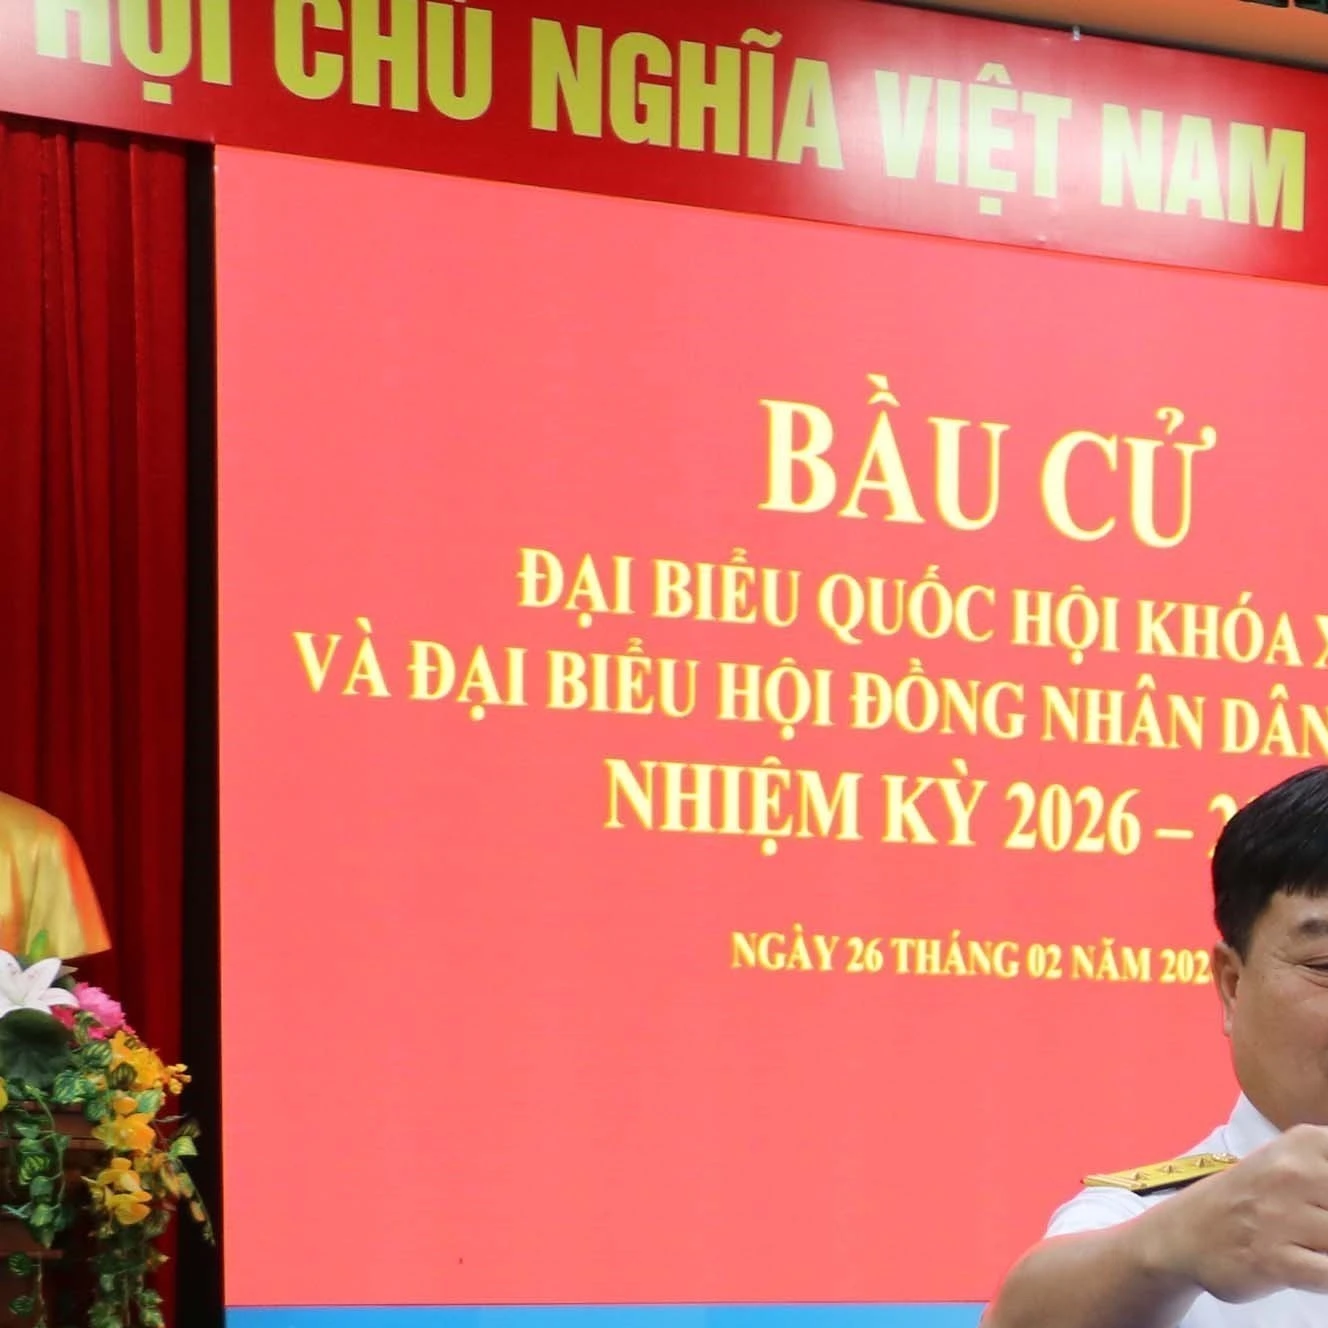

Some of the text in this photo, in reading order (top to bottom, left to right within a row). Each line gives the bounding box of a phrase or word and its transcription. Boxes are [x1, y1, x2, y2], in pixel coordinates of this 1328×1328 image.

[273, 0, 494, 121] CHỦ
[530, 27, 845, 170] NGHĨA
[874, 61, 1073, 215] VIỆT
[1100, 101, 1306, 233] NAM
[758, 373, 1217, 548] BẦU CỬ
[517, 547, 635, 629] ĐẠI
[653, 547, 801, 628] BIỂU
[817, 565, 995, 645] QUỐC
[1010, 585, 1120, 665] HỘI
[1137, 592, 1304, 668] KHÓA
[293, 617, 391, 698] VÀ
[407, 640, 529, 721] ĐẠI
[547, 637, 699, 718] BIỂU
[718, 657, 835, 741] HỘI
[850, 658, 1027, 740] ĐỒNG
[1040, 674, 1206, 752] NHÂN
[604, 756, 863, 857] NHIỆM
[881, 758, 988, 848] KỲ
[1005, 782, 1142, 856] 2026
[731, 922, 1213, 985] NGÀY 26 THÁNG 02 NĂM 202
